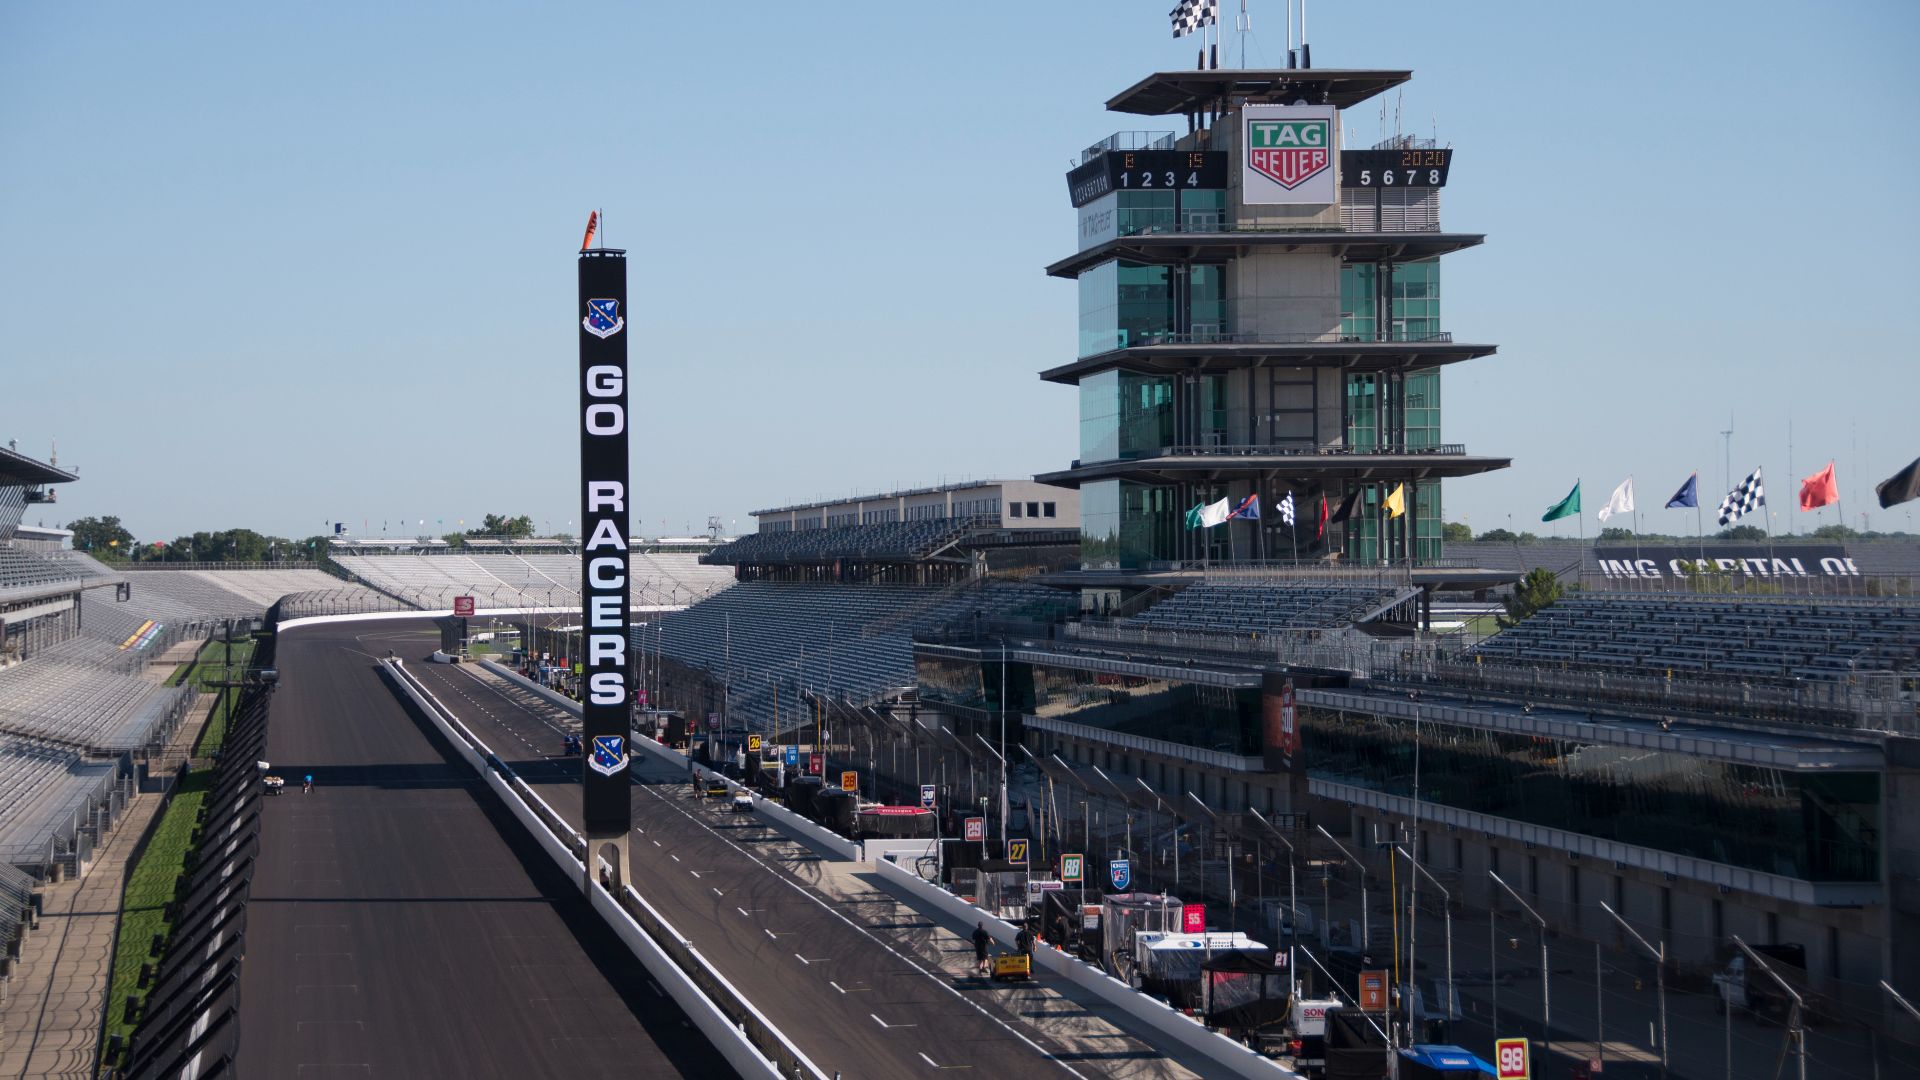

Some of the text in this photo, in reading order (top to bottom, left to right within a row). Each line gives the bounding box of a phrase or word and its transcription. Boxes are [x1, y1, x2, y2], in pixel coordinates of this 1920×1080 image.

[1256, 125, 1321, 146] TAG
[1254, 151, 1325, 182] HEUER
[1120, 171, 1198, 187] 1 2 3 4
[1360, 170, 1371, 185] 5
[1383, 170, 1394, 185] 6
[1406, 170, 1417, 185] 7
[1429, 170, 1440, 185] 8
[585, 365, 625, 436] GO
[585, 480, 628, 705] RACERS
[750, 737, 760, 749] 26
[967, 821, 982, 837] 29
[1010, 843, 1026, 860] 27
[1063, 859, 1080, 877] 88
[1113, 869, 1127, 882] 15
[1188, 913, 1201, 924] 55
[1274, 951, 1288, 967] 21
[1370, 991, 1377, 1003] 9
[1501, 1047, 1524, 1072] 98
